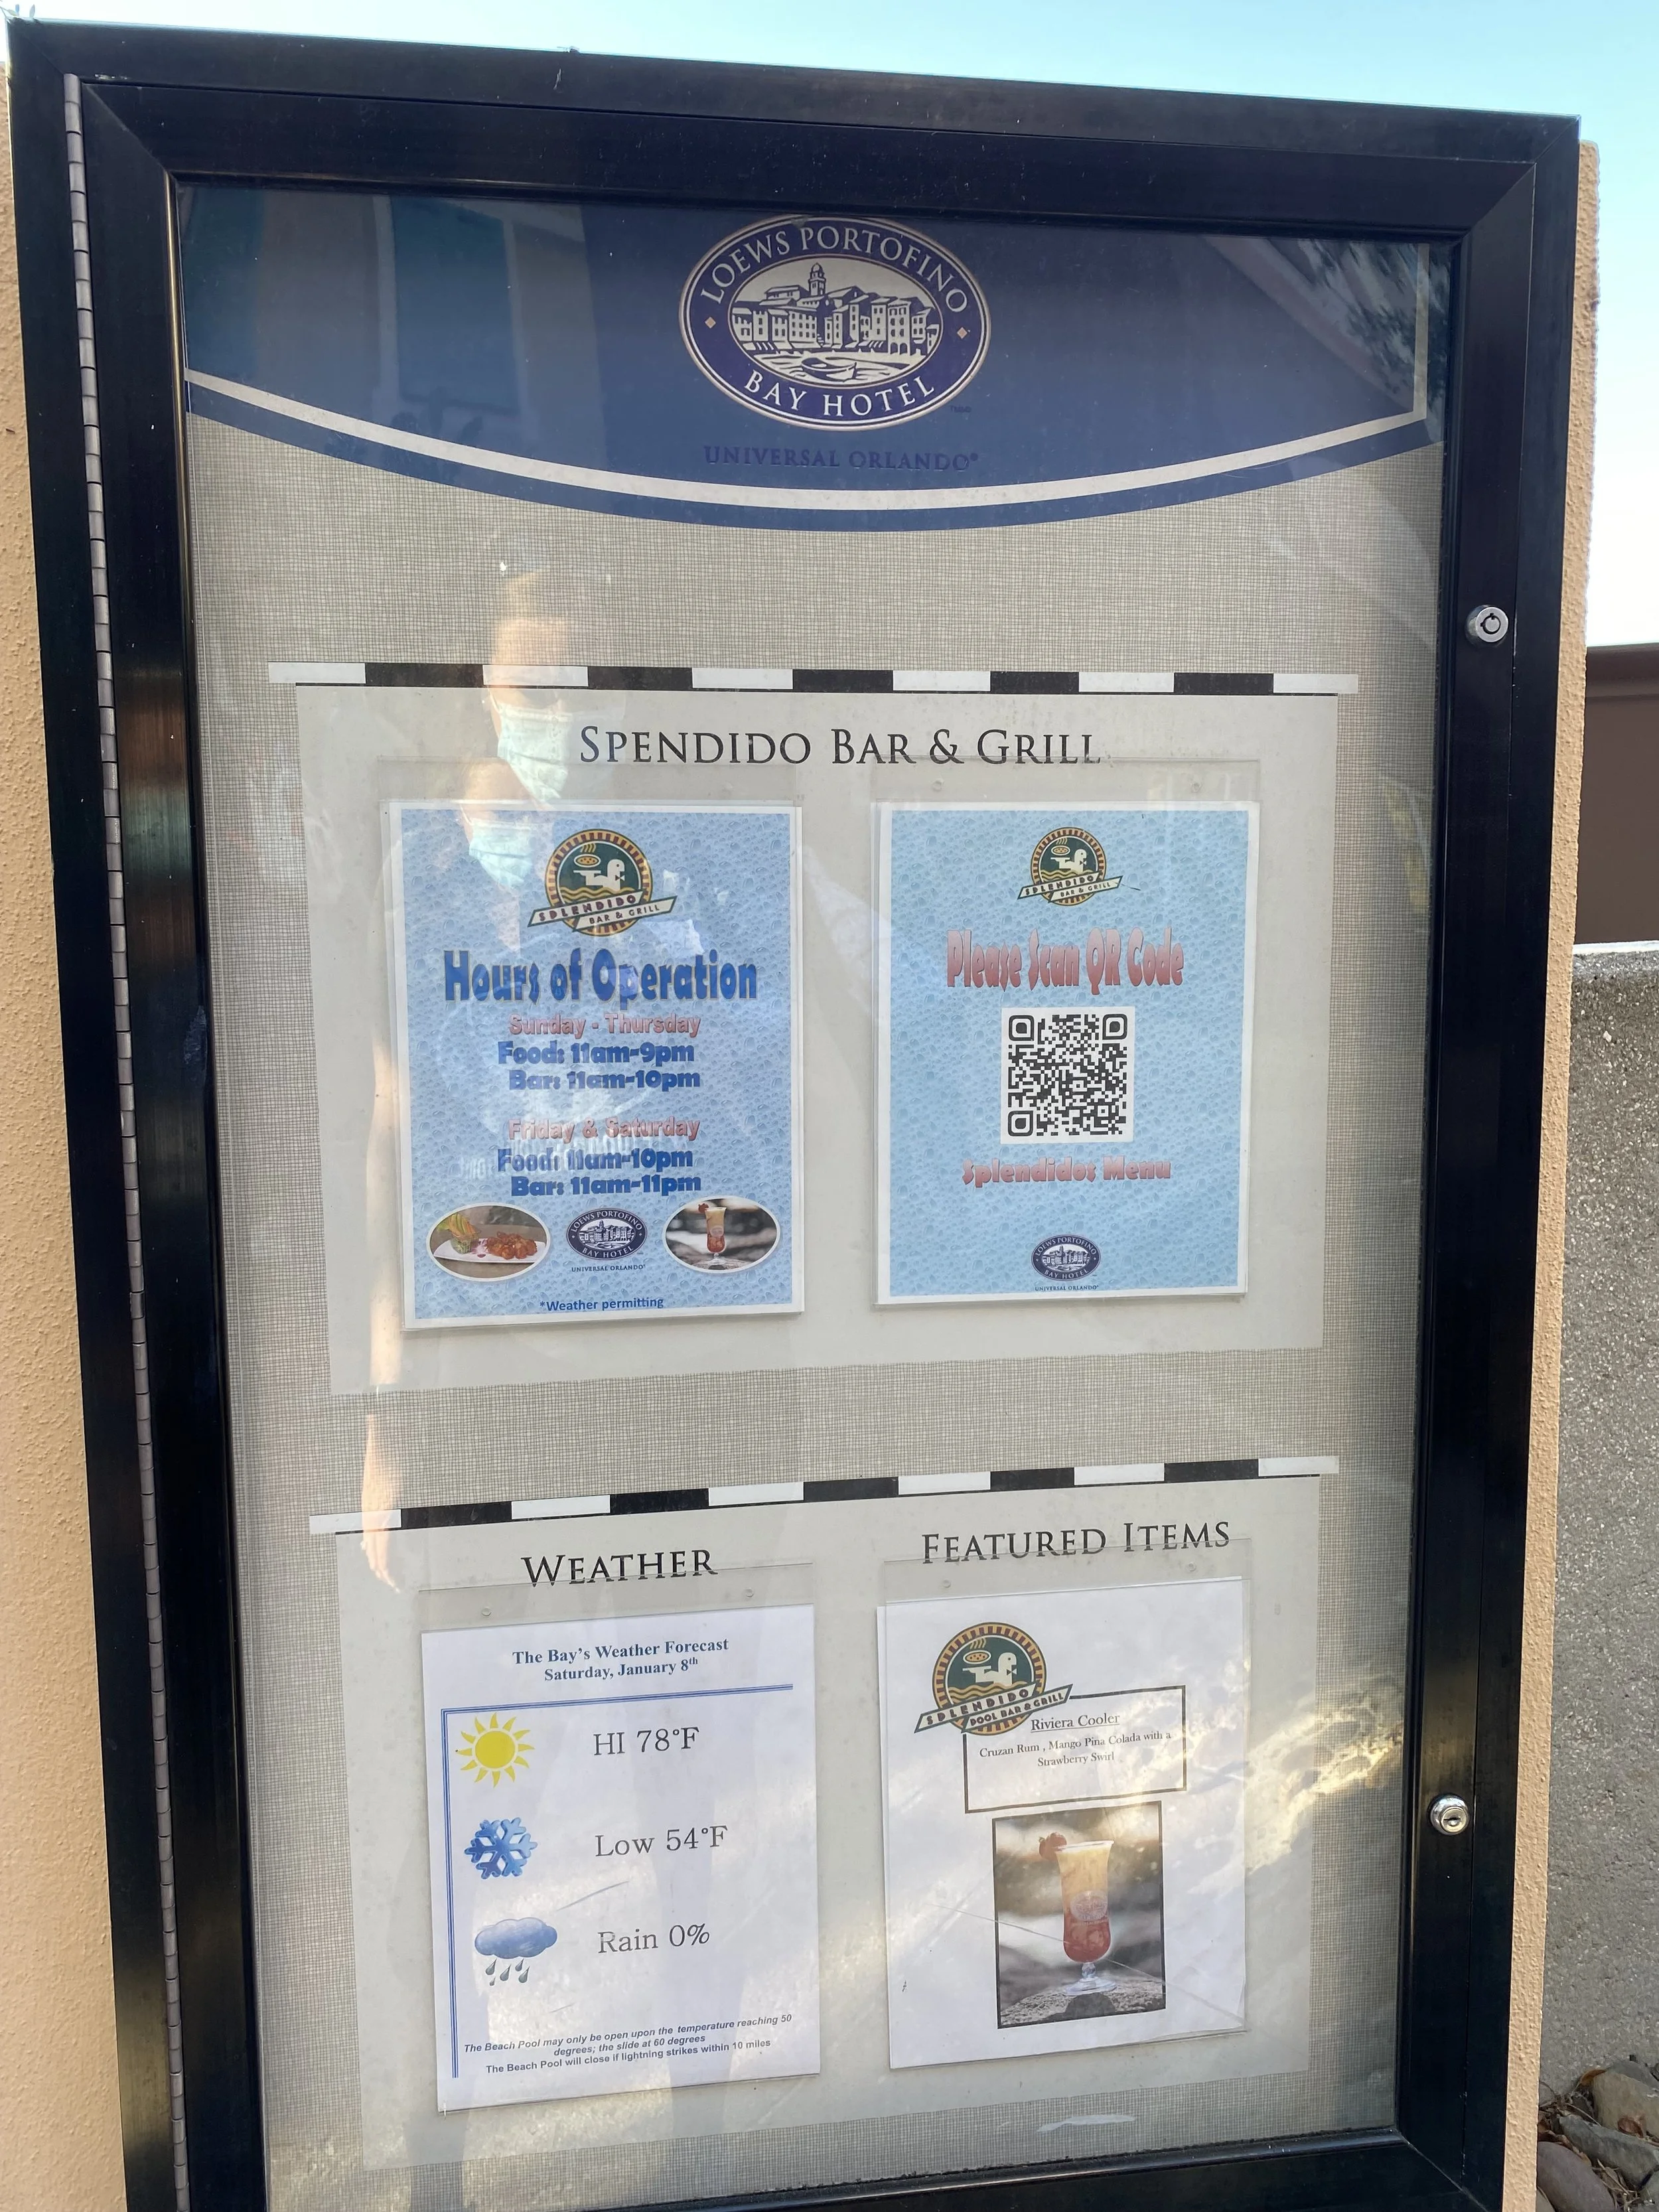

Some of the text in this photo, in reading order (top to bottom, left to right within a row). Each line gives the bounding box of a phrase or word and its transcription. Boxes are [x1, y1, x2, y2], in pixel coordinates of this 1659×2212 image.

[700, 226, 968, 313] LOEWS PORTOFINO
[744, 370, 934, 416] BAY HOTEL
[704, 445, 839, 467] UNIVERSAL
[580, 725, 1101, 765] SPENDIDO BAR & GRILL
[1088, 882, 1111, 891] GRILL
[589, 915, 610, 924] BAR
[628, 905, 660, 917] GRILL
[947, 926, 1184, 995] Please Scan QR Code
[443, 947, 758, 1010] Hours of Operation
[508, 1013, 587, 1039] Sunday
[605, 1013, 701, 1038] Thursday
[498, 1040, 695, 1067] Food: 11am-9pm
[508, 1069, 701, 1092] Bar: 11am-10pm
[508, 1116, 700, 1143] Friday & Saturday
[497, 1147, 560, 1172] Food:
[567, 1147, 693, 1171] 11am-10pm
[962, 1155, 1171, 1188] Splendidos Menu
[511, 1174, 701, 1197] Bar: 11am-11pm
[571, 1211, 642, 1233] LOEWS PORTOFINO
[582, 1246, 633, 1258] BAY HOTEL
[1035, 1236, 1096, 1256] LOEWS PORTOFINO
[1044, 1269, 1088, 1279] BAY HOTEL
[602, 1297, 664, 1311] permitting
[922, 1521, 1230, 1564] FEATURED ITEMS
[521, 1549, 719, 1587] WEATHER
[512, 1651, 543, 1664] The
[595, 1643, 660, 1659] Weather
[665, 1638, 729, 1653] Forecast
[544, 1657, 698, 1681] Saturday, January 8th
[1001, 1706, 1022, 1719] BAR
[1033, 1692, 1064, 1707] GRILL
[1031, 1712, 1120, 1731] Riviera Cooler
[593, 1726, 699, 1755] HI 78°F
[979, 1747, 1013, 1757] Cruzan
[1017, 1743, 1040, 1753] Rum
[1048, 1739, 1082, 1751] Mango
[1084, 1737, 1106, 1747] Pina
[1108, 1733, 1141, 1745] Colada
[1143, 1731, 1163, 1740] with
[1037, 1751, 1114, 1767] Strawberry Swirl
[595, 1825, 728, 1857] Low 54°F
[597, 1923, 710, 1954] Rain 0%
[465, 2044, 482, 2053] The
[484, 2041, 515, 2051] Beach
[518, 2039, 540, 2049] Pool
[543, 2037, 563, 2047] may
[566, 2035, 587, 2045] only
[589, 2033, 601, 2042] be
[604, 2031, 628, 2041] open
[631, 2029, 656, 2039] upon
[677, 2022, 735, 2033] temperature
[737, 2016, 778, 2028] reaching
[780, 2014, 792, 2023] 50
[553, 2047, 596, 2057] degrees;
[599, 2043, 614, 2052] the
[616, 2041, 639, 2050] slide
[668, 2035, 705, 2046] degrees
[486, 2065, 504, 2073] The
[507, 2062, 538, 2072] Beach
[540, 2059, 562, 2069] Pool
[565, 2056, 581, 2066] will
[584, 2055, 610, 2064] close
[621, 2050, 664, 2061] lightning
[666, 2046, 698, 2057] strikes
[701, 2043, 729, 2053] within
[746, 2039, 770, 2049] miles
